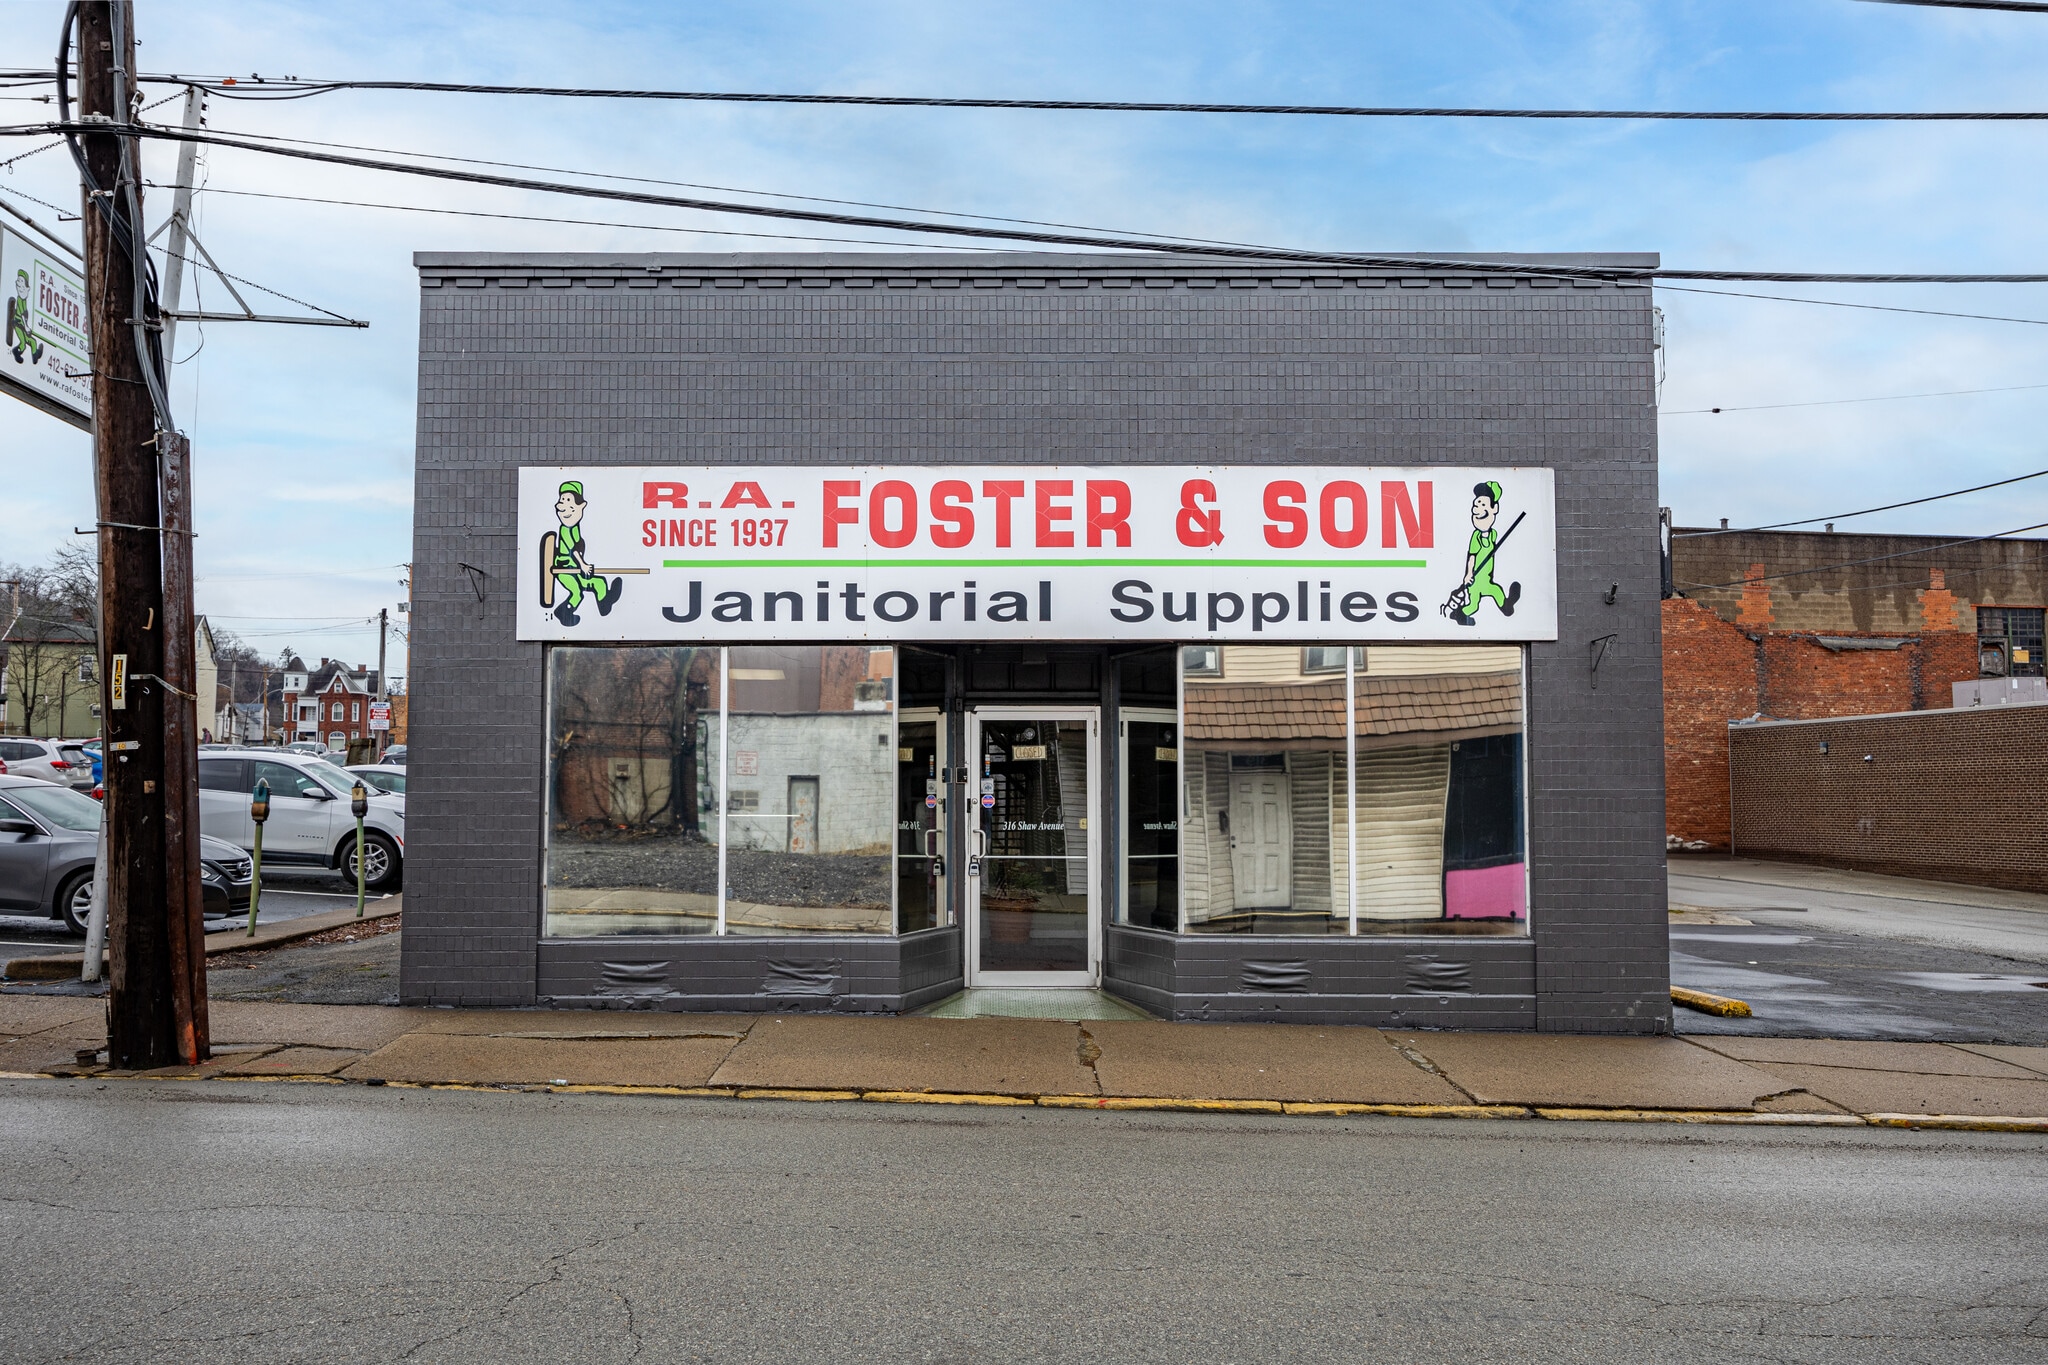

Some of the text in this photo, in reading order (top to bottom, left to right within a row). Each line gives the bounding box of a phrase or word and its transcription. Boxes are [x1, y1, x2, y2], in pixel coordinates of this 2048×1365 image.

[40, 283, 80, 330] FOSTER
[63, 284, 78, 300] Since
[38, 317, 77, 347] Janitorial
[643, 479, 1434, 549] R.A. FOSTER & SON
[642, 519, 789, 547] SINCE 1937
[661, 579, 1420, 632] Janitorial Supplies
[114, 659, 123, 700] 152
[1015, 746, 1043, 759] CLOSED
[1002, 820, 1065, 831] 316 Shaw Avenue
